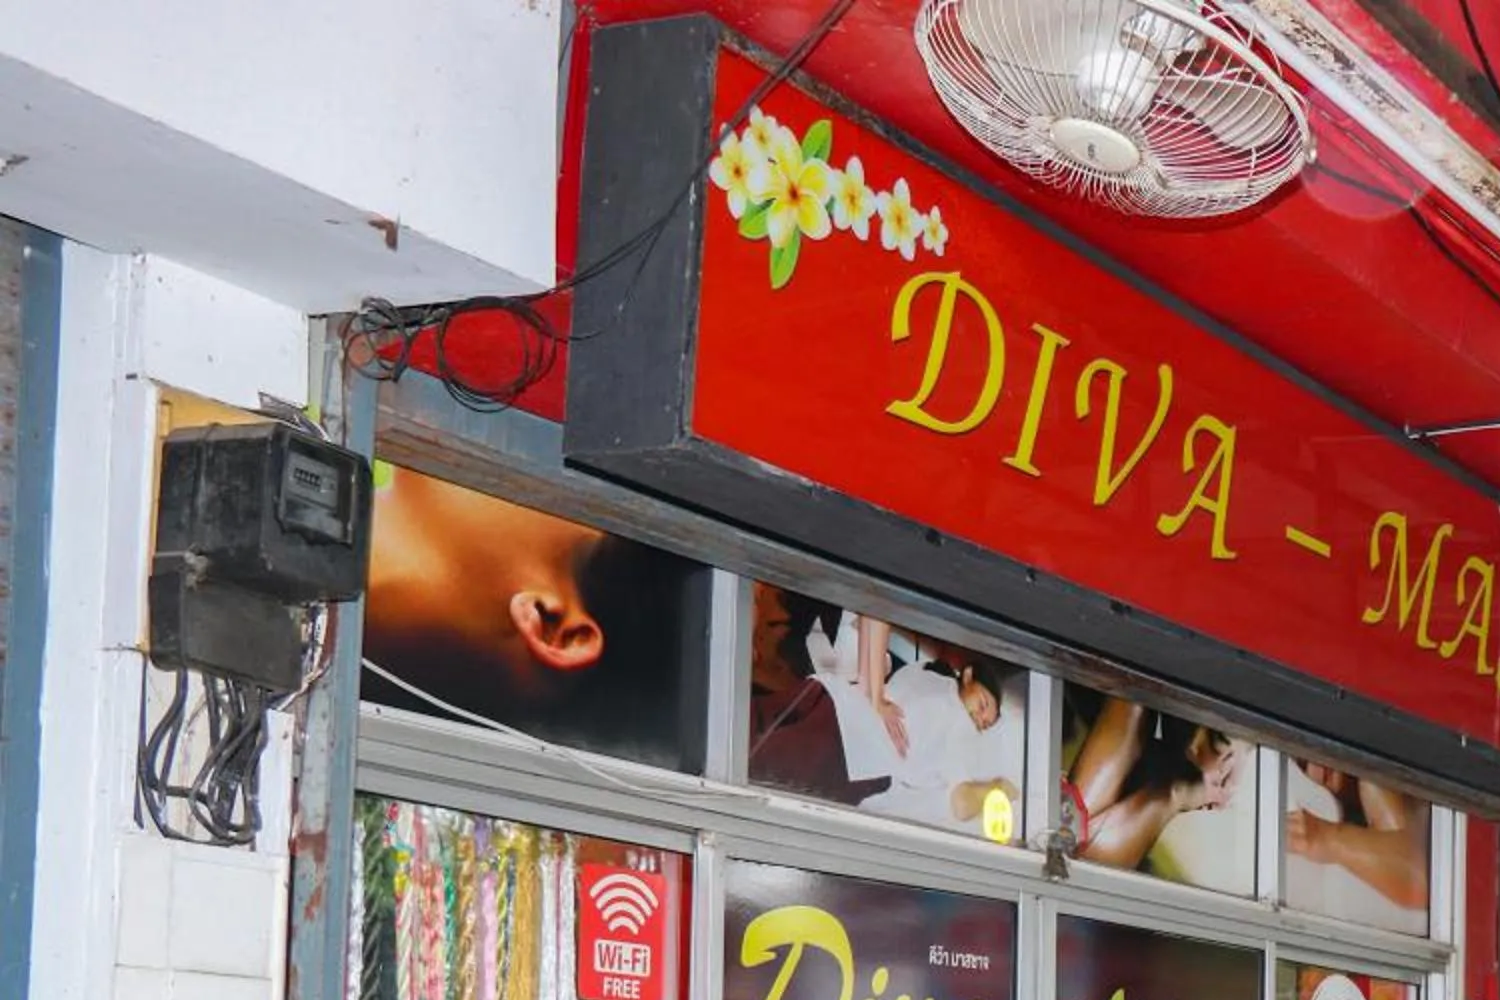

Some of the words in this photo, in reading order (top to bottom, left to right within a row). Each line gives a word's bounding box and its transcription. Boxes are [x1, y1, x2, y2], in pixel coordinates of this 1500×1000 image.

[886, 271, 1237, 559] DIVA
[597, 943, 648, 973] Wi-Fi
[603, 976, 641, 1000] FREE
